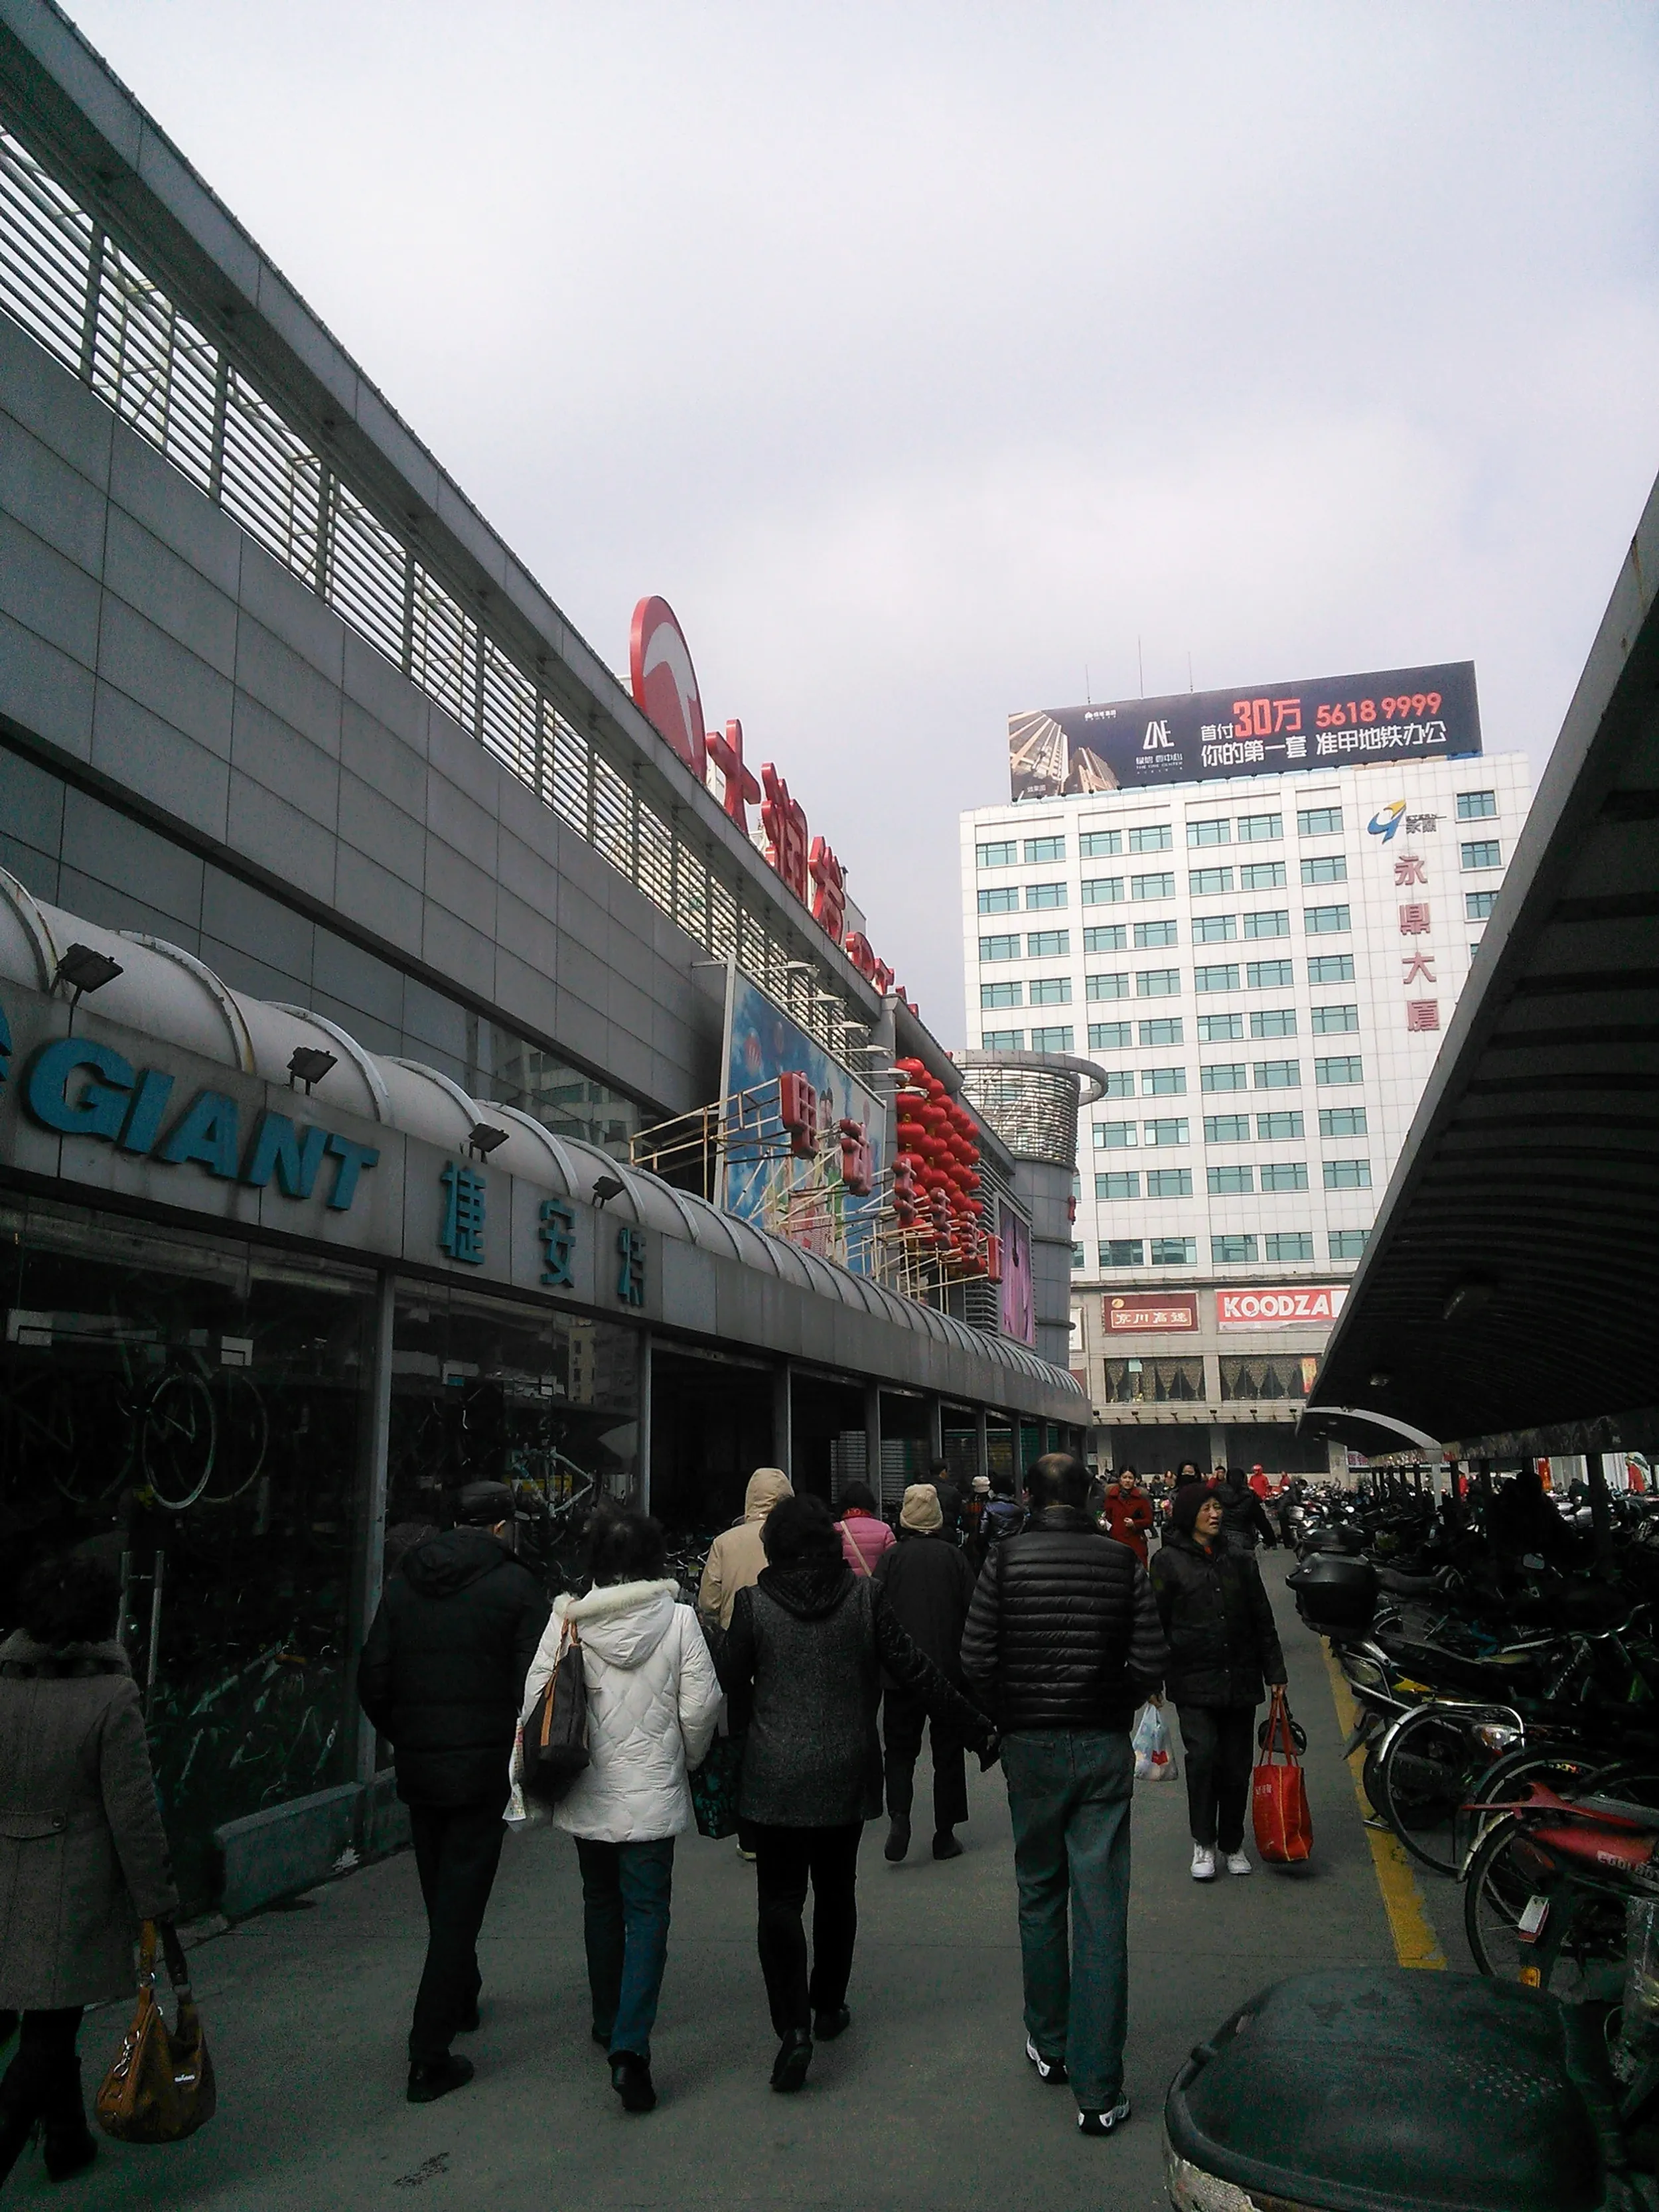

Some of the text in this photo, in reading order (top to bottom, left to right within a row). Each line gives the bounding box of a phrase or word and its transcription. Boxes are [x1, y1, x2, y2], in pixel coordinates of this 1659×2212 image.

[1315, 700, 1377, 727] 5618
[1381, 692, 1442, 720] 9999
[1201, 720, 1447, 768] 你的第一套 准甲地铁办公
[25, 1037, 381, 1212] GIANT
[1223, 1293, 1331, 1318] KOODZA
